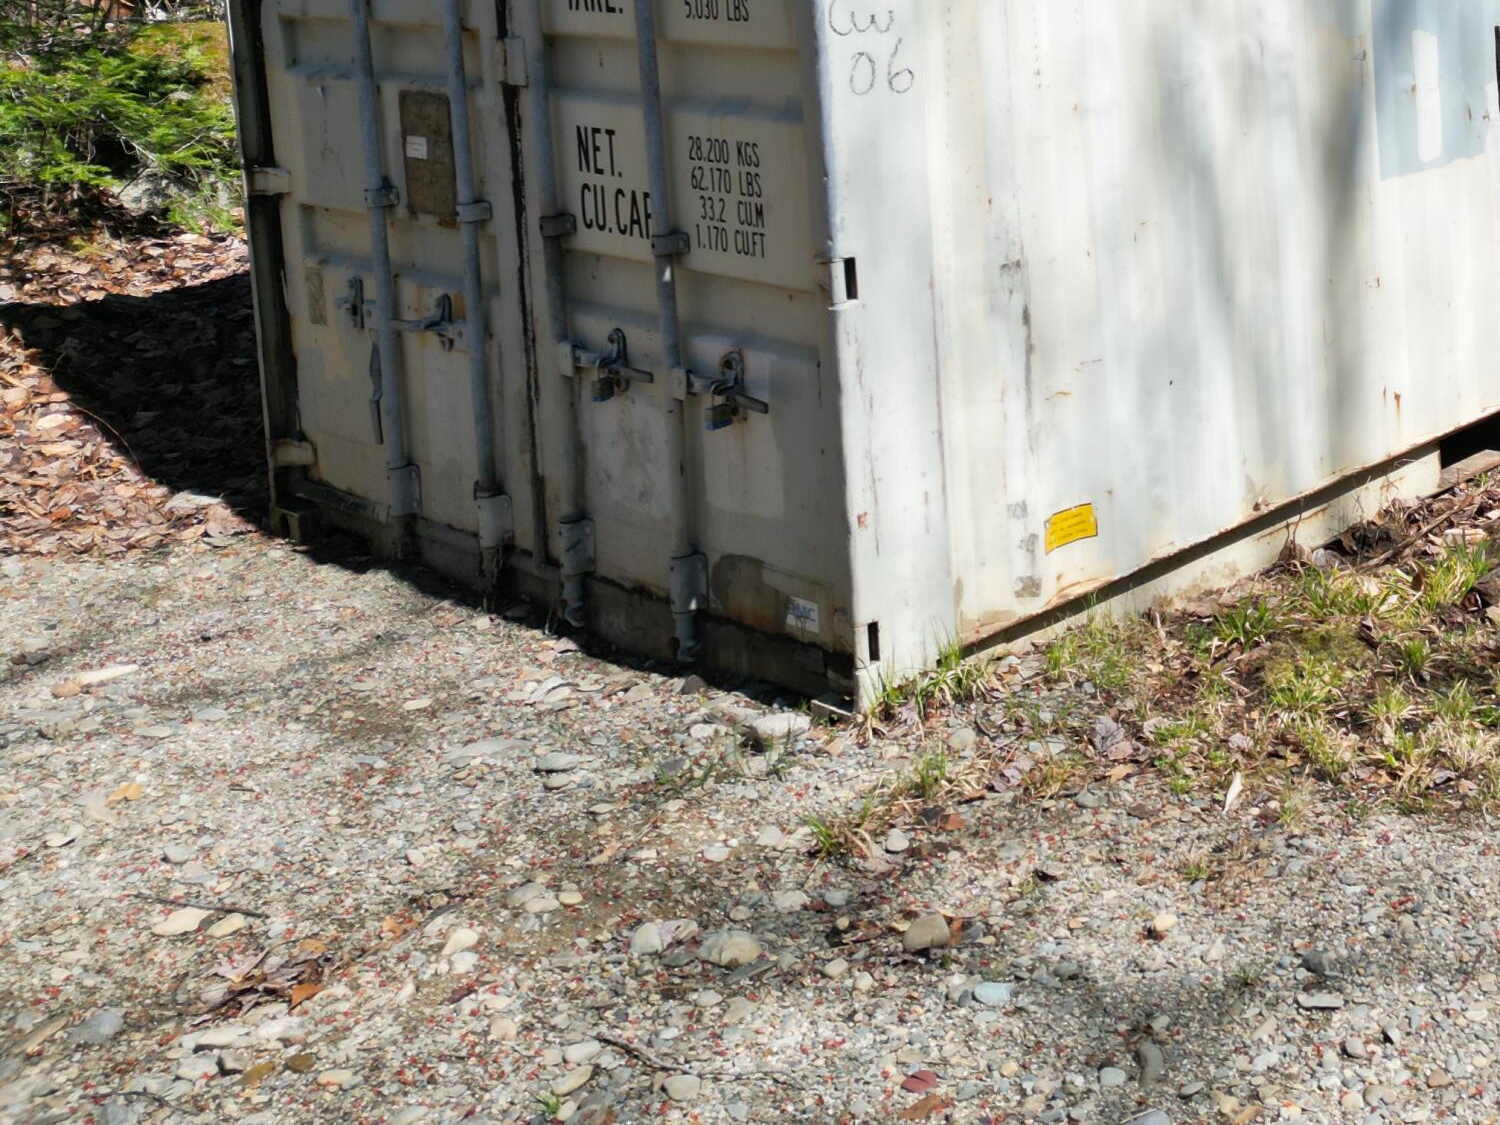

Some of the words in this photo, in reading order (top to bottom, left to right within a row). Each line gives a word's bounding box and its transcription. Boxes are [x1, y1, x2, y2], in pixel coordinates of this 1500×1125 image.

[849, 37, 914, 96] 06
[576, 125, 622, 178] NET.
[688, 135, 730, 165] 28.200
[736, 140, 760, 169] KGS
[690, 166, 732, 195] 62.170
[738, 170, 763, 199] LBS
[699, 195, 727, 223] 33.2
[696, 223, 728, 252] 1.170
